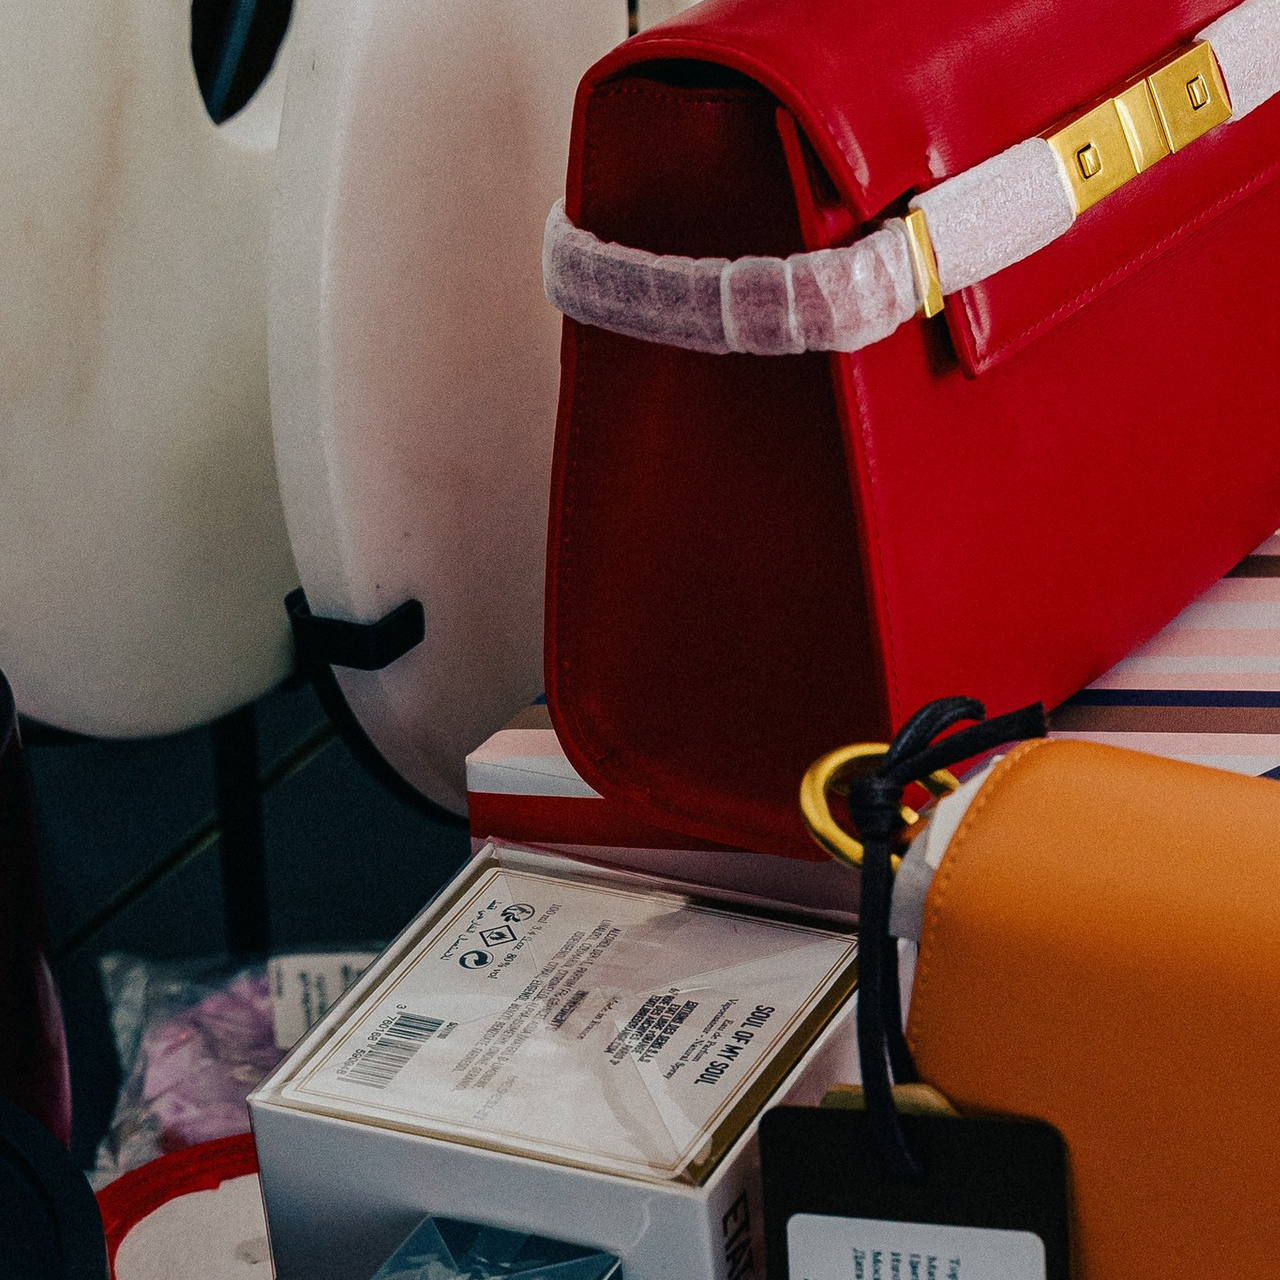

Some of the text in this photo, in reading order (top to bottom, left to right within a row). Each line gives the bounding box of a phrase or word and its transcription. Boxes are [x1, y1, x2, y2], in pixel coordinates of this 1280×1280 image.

[525, 925, 543, 935] 3.4
[496, 953, 518, 968] 80%
[485, 968, 504, 979] vol
[698, 997, 738, 1034] Vaporisateur
[365, 1015, 397, 1041] 760168
[678, 1038, 705, 1061] Natural
[691, 1019, 734, 1062] Eau de Parfum
[693, 1004, 776, 1087] SOUL OF MY SOUL
[334, 1048, 367, 1075] 590948
[660, 1061, 685, 1079] Spray
